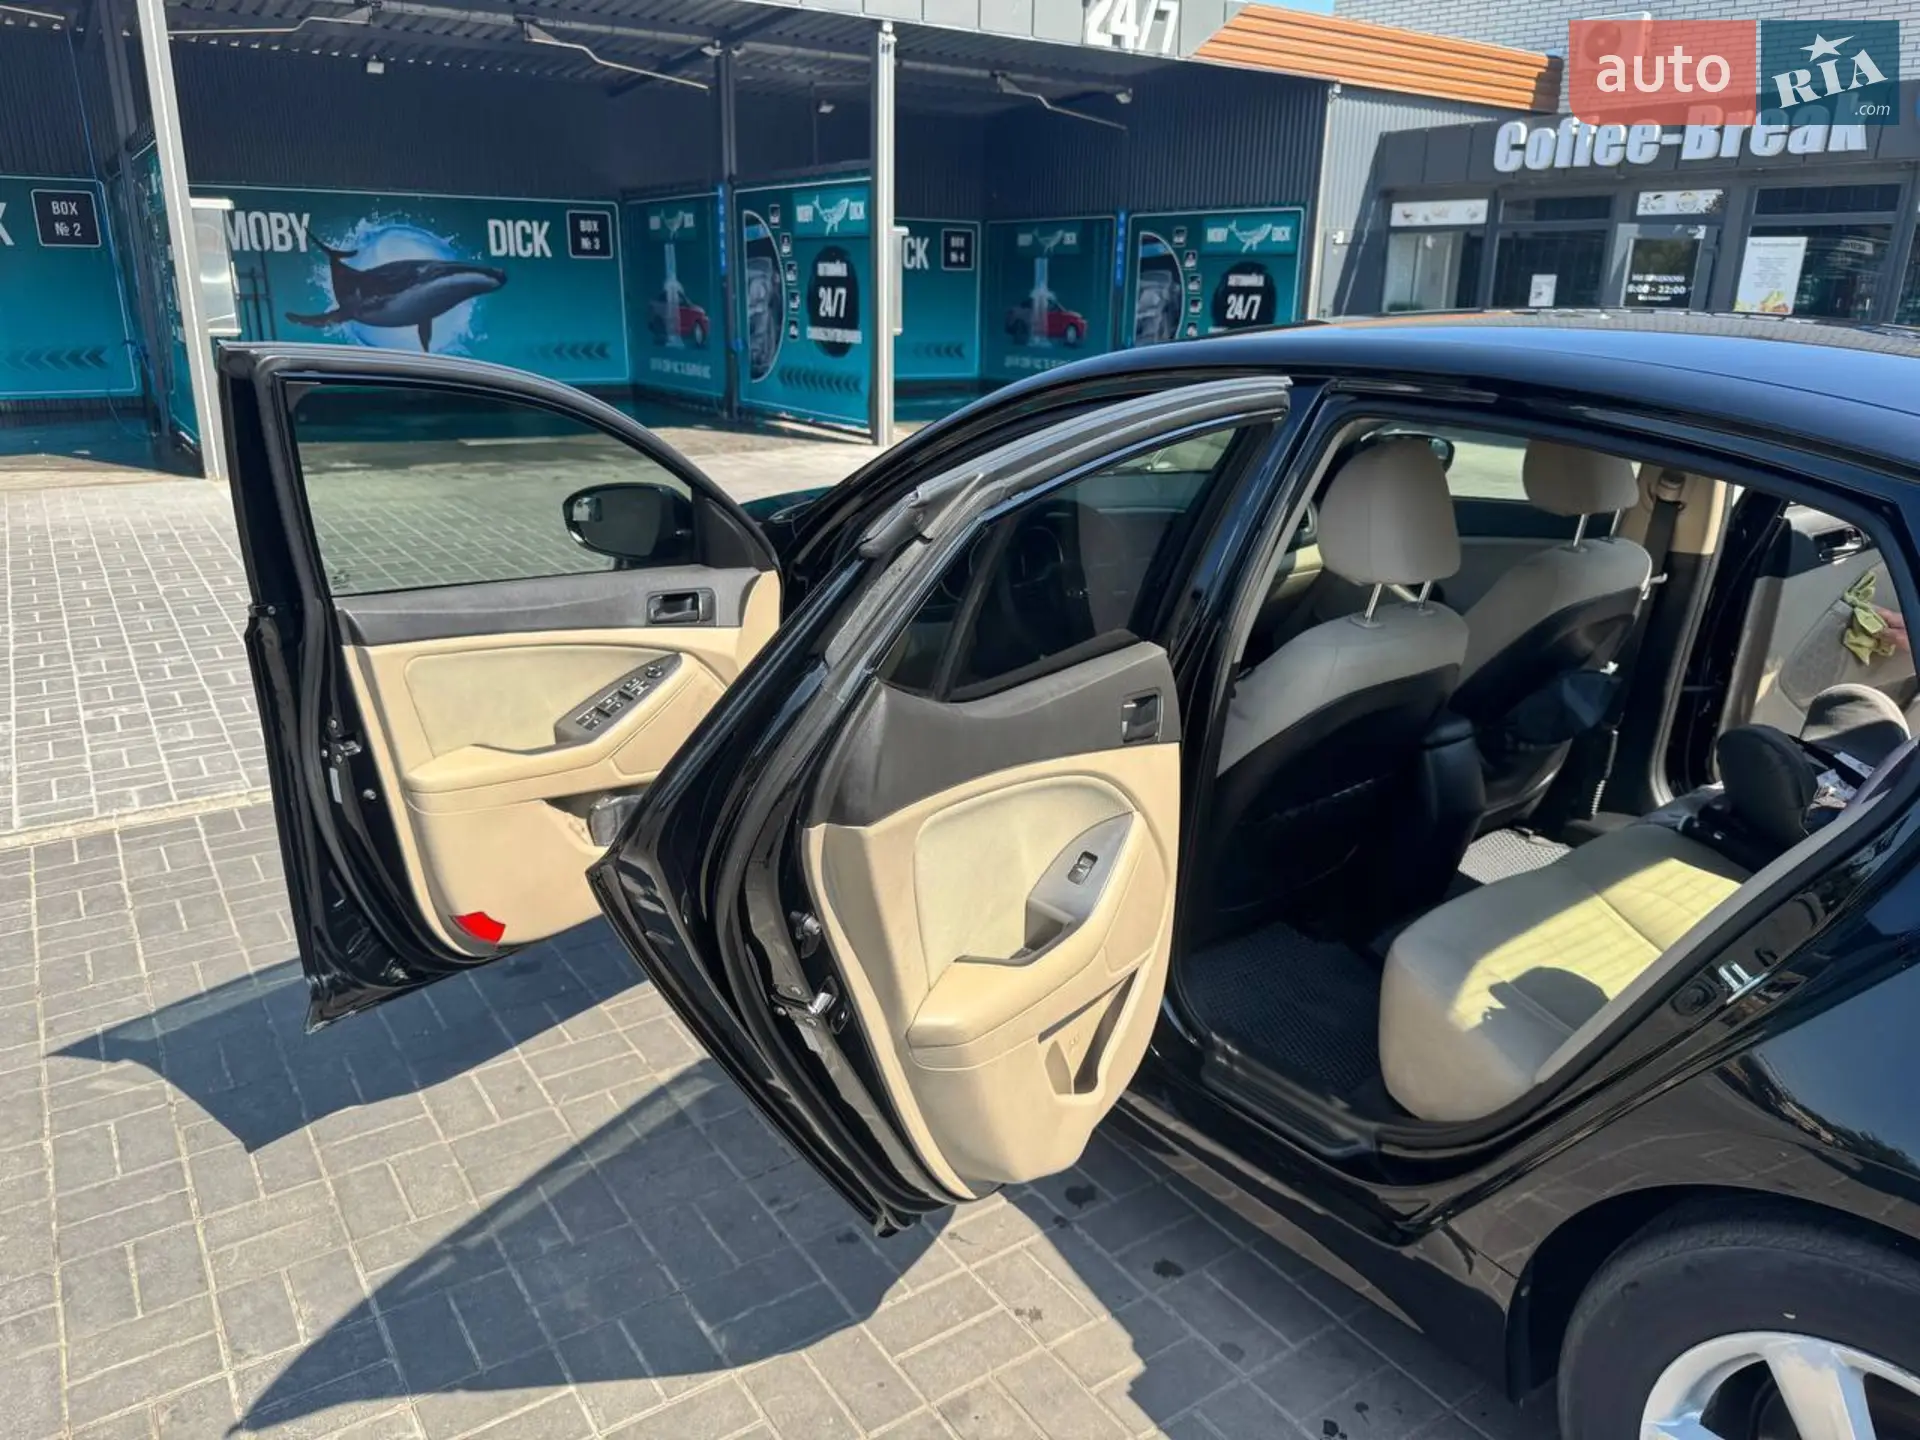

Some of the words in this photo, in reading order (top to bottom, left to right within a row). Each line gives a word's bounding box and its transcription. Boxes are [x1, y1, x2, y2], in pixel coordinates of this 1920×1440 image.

[1087, 0, 1179, 54] 24/7
[1493, 93, 1870, 173] Coffee-Break
[51, 200, 79, 216] BOX
[54, 222, 70, 236] №
[73, 223, 81, 237] 2
[224, 210, 310, 253] MOBY
[487, 219, 553, 258] DICK
[903, 236, 930, 271] CK
[818, 286, 847, 319] 24/7
[1226, 293, 1262, 322] 24/7
